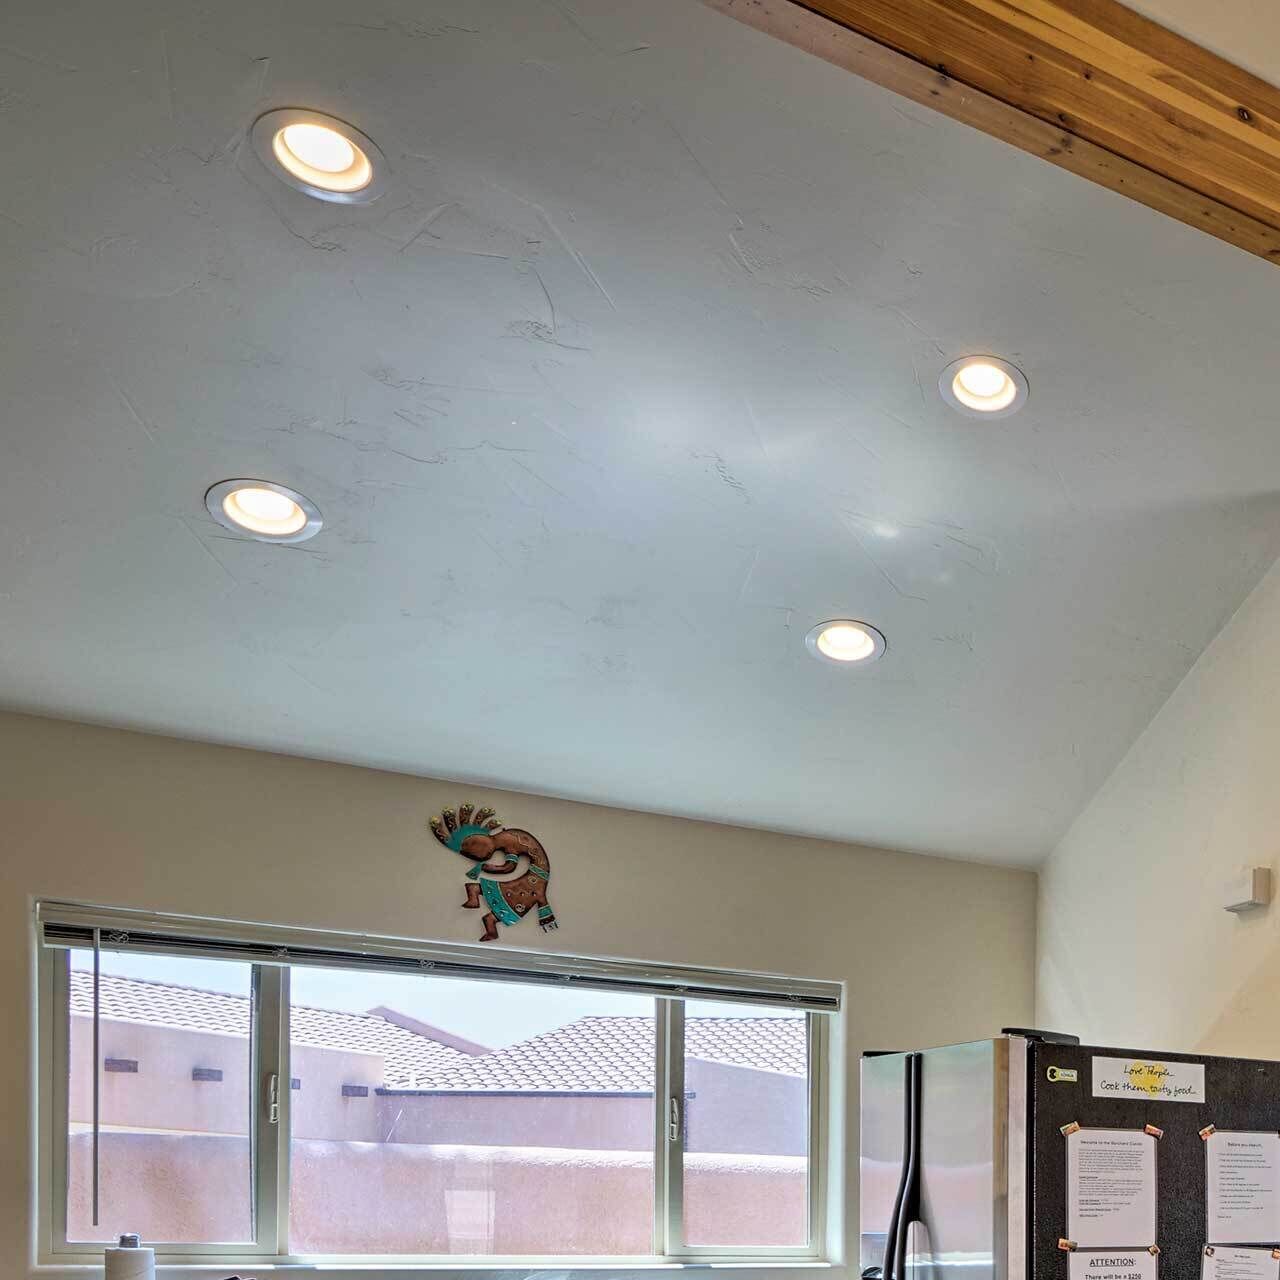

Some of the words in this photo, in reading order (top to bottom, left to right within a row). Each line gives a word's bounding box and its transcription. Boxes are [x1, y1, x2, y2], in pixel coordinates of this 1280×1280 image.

[1123, 1064, 1143, 1075] Love
[1100, 1080, 1120, 1091] Cook
[1122, 1082, 1146, 1092] them
[1150, 1085, 1172, 1096] tasty
[1089, 1258, 1136, 1267] ATTENTION:
[1128, 1272, 1142, 1280] $250
